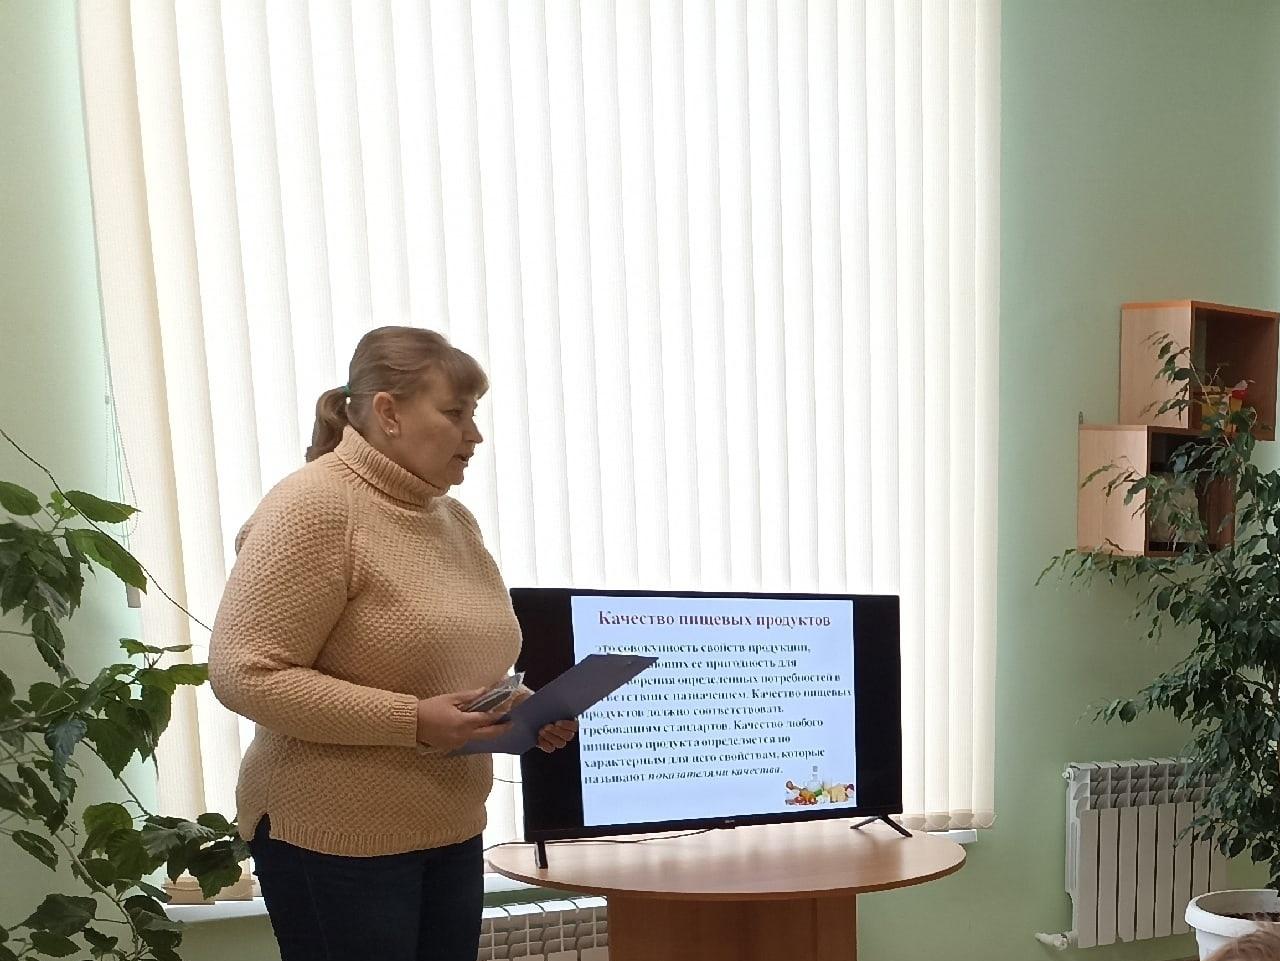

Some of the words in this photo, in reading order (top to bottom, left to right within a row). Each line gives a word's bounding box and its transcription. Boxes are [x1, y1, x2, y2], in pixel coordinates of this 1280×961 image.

[599, 610, 675, 626] Качество
[679, 615, 752, 627] пищевых
[756, 615, 832, 629] продуктов
[700, 643, 746, 653] свойств
[751, 688, 801, 699] Качество
[803, 688, 852, 698] пищевых
[734, 719, 784, 731] Качество
[785, 718, 824, 728] любого
[582, 741, 643, 752] пищевого
[645, 738, 700, 752] продукта
[781, 749, 825, 760] которые
